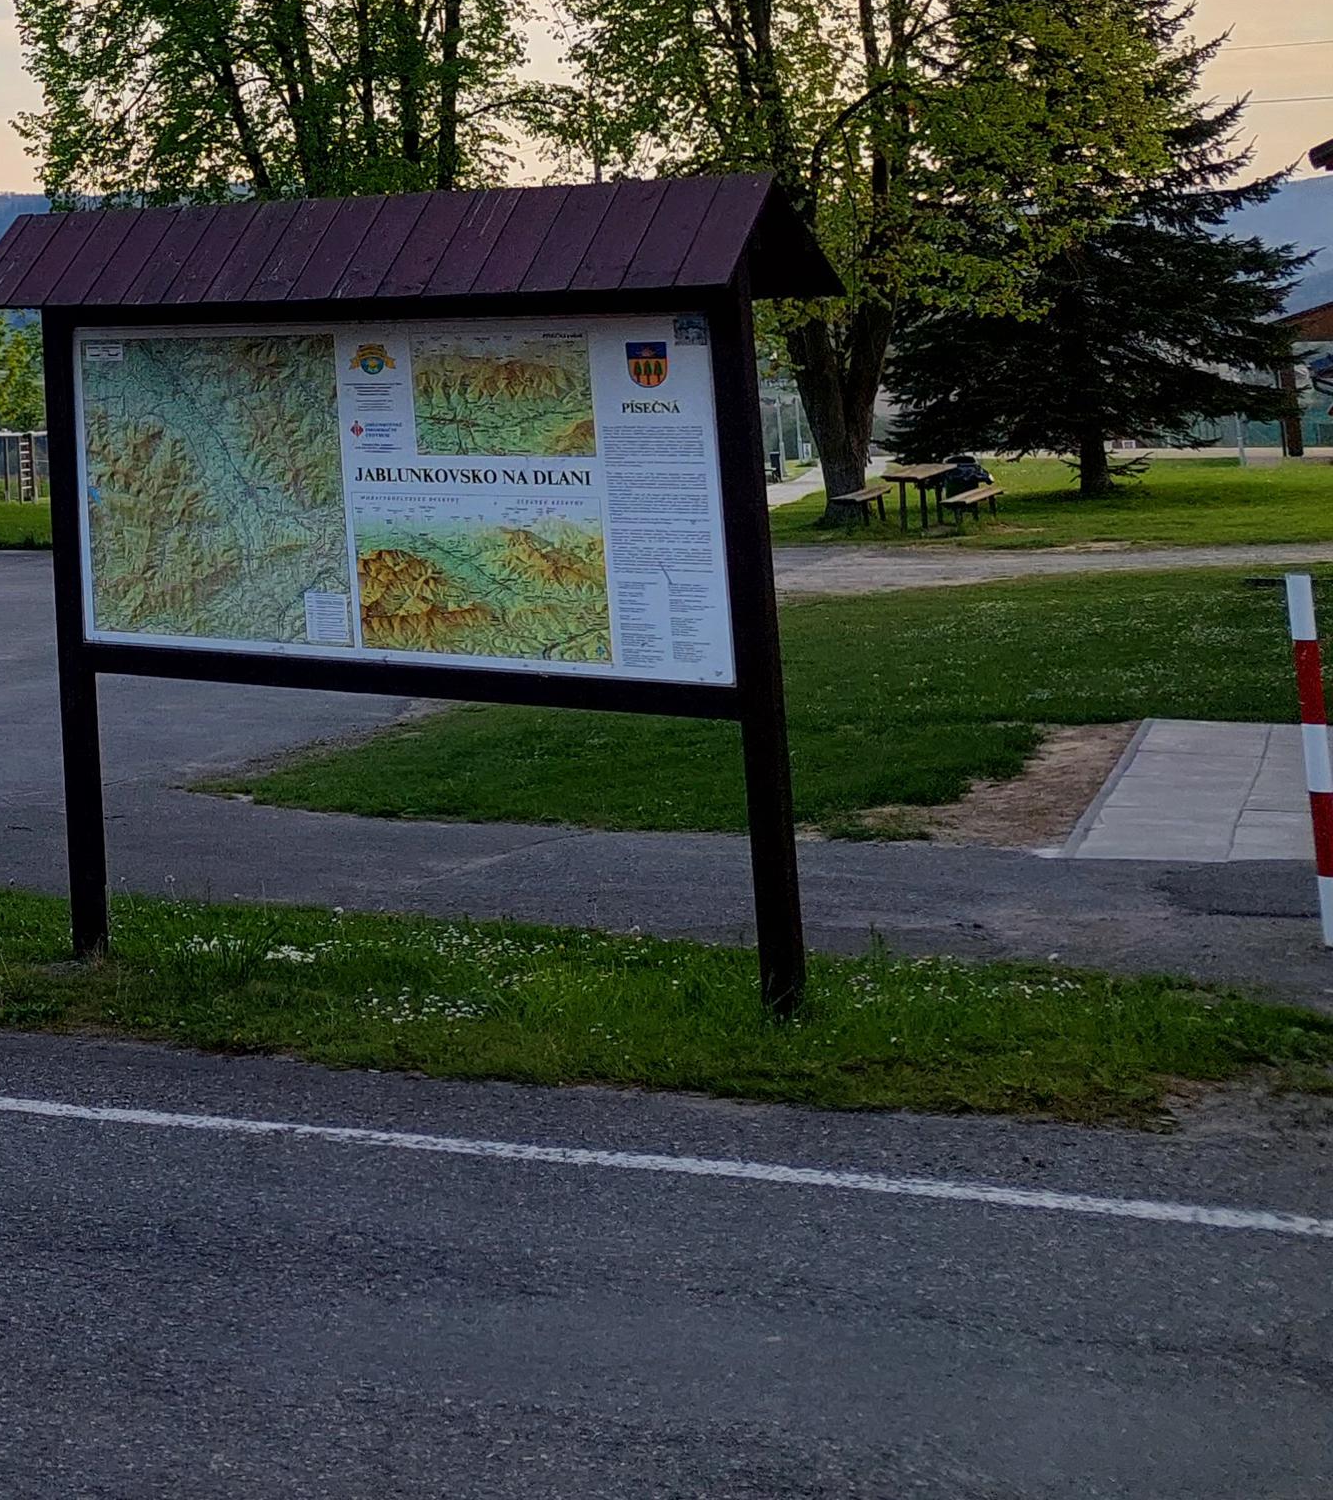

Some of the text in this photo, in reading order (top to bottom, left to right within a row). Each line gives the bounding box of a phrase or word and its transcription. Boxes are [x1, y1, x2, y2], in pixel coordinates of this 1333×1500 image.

[622, 400, 680, 413] PÍSEČNÁ
[355, 467, 591, 486] JABLUNKOVSKO NA DLANI
